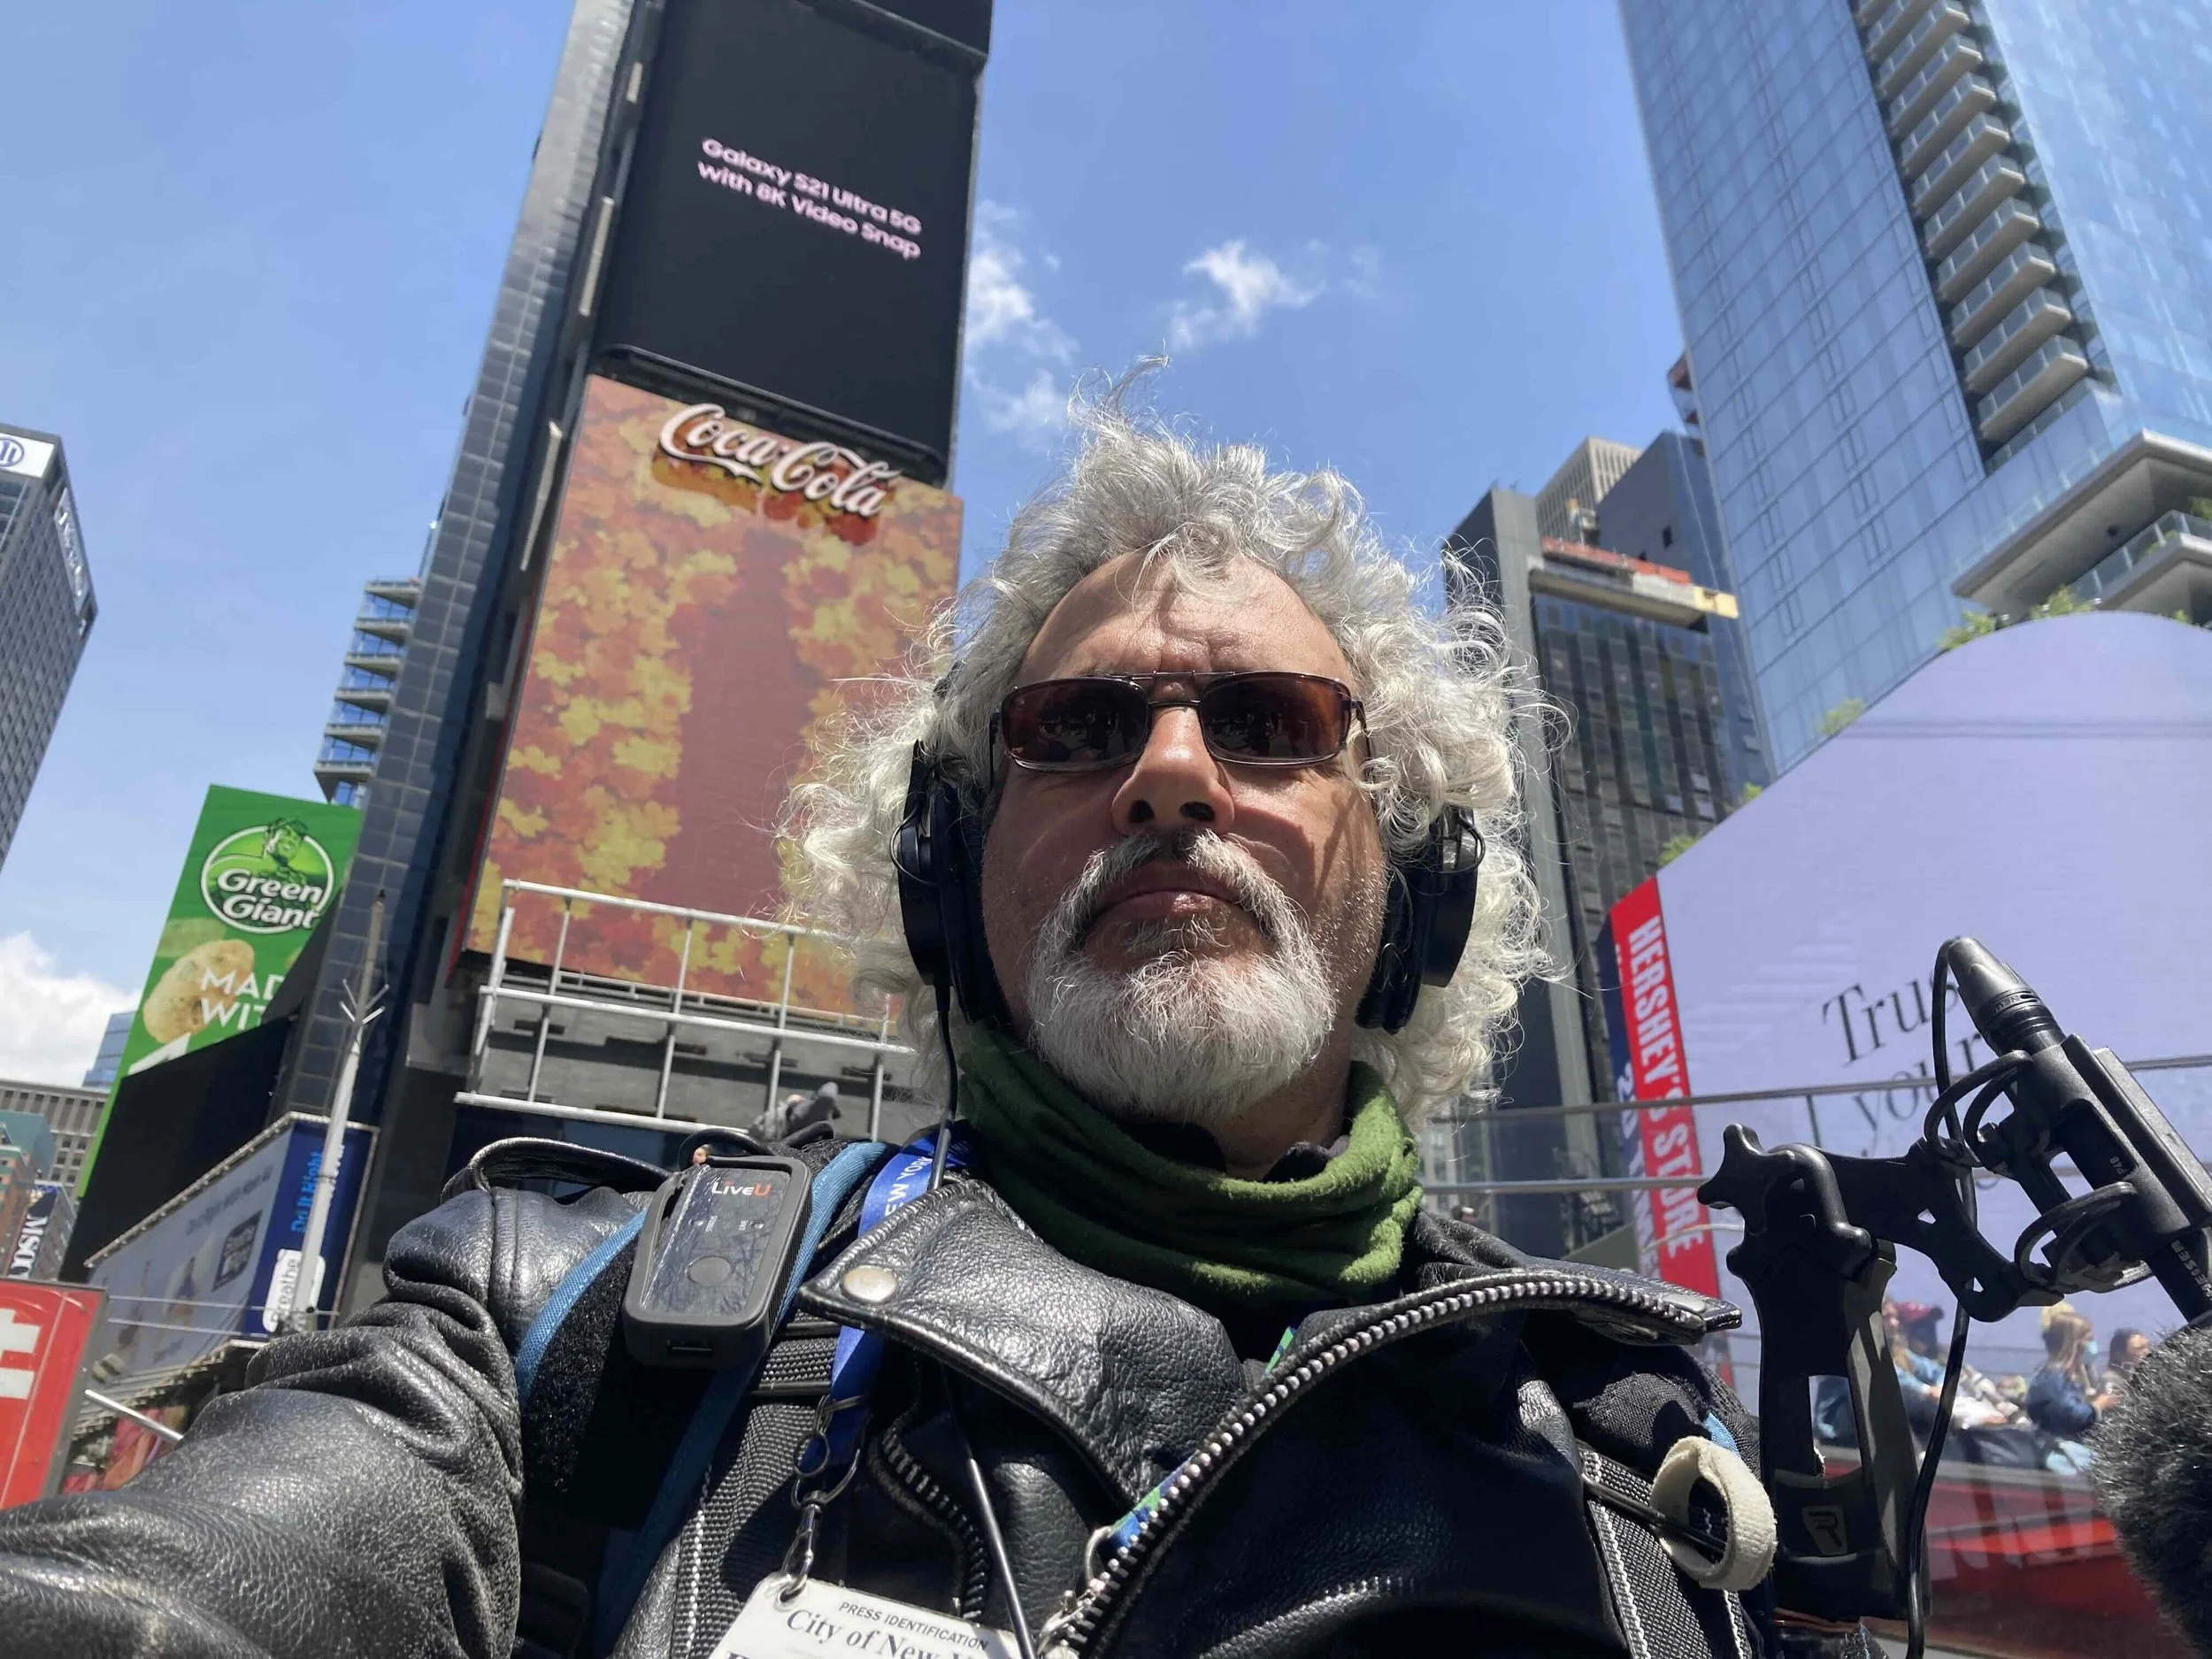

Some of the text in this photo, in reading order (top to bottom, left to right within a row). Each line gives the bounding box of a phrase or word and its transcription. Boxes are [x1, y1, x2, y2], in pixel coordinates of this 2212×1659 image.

[697, 161, 922, 260] with 8K Video Snap
[701, 137, 923, 235] Galaxy S21 Ultra 5G
[218, 868, 323, 903] Green
[223, 894, 321, 929] Giant
[1628, 915, 1685, 1123] HERSHEY'S
[1822, 969, 1960, 1069] Trus
[885, 1183, 910, 1217] EW
[1653, 1123, 1704, 1259] STORE
[2170, 1239, 2212, 1302] HEISER
[786, 1609, 843, 1645] City
[846, 1627, 880, 1651] of
[838, 1601, 989, 1651] PRESS IDENTIFICATION
